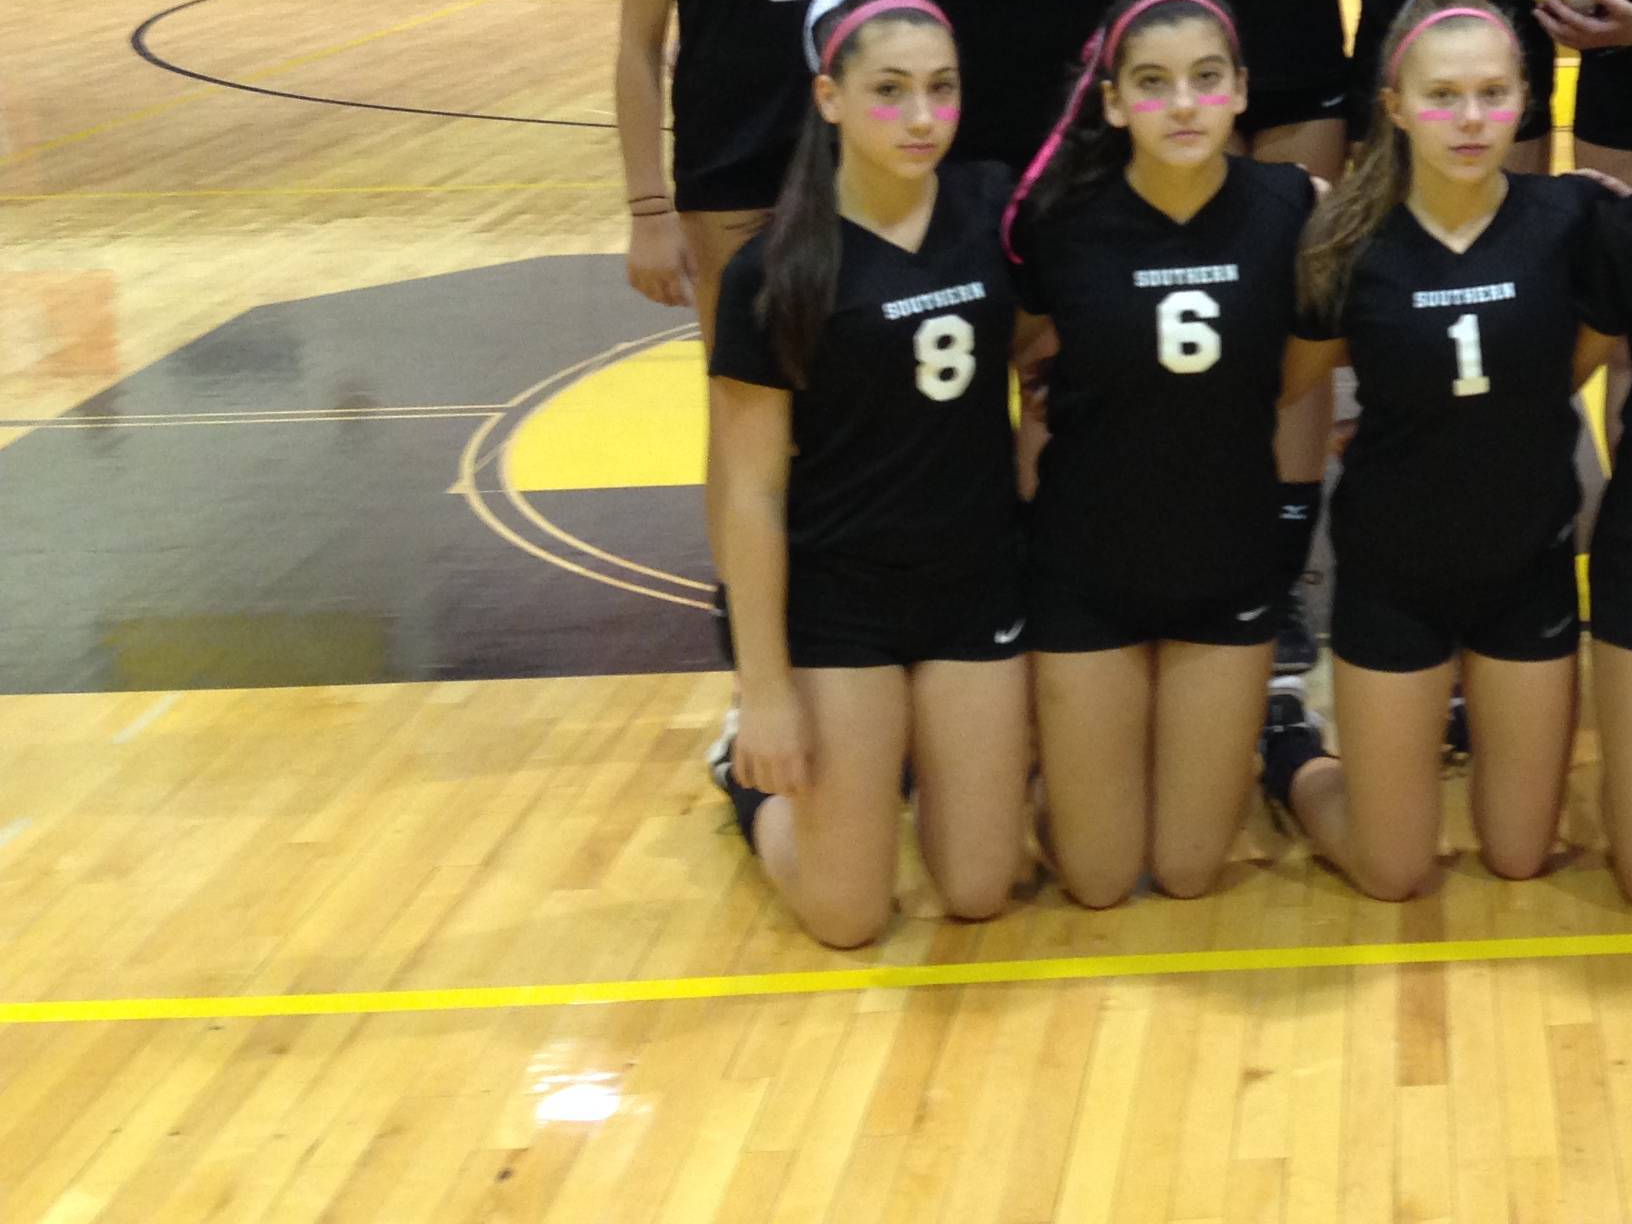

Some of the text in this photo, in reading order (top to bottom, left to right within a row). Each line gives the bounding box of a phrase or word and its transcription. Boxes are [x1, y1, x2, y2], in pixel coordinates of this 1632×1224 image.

[882, 282, 986, 320] SOUTHERN
[1133, 264, 1240, 288] SOUTHERN
[1412, 282, 1516, 309] SOUTHERN
[913, 314, 976, 402] 8
[1156, 291, 1222, 374] 6
[1447, 313, 1490, 397] 1
